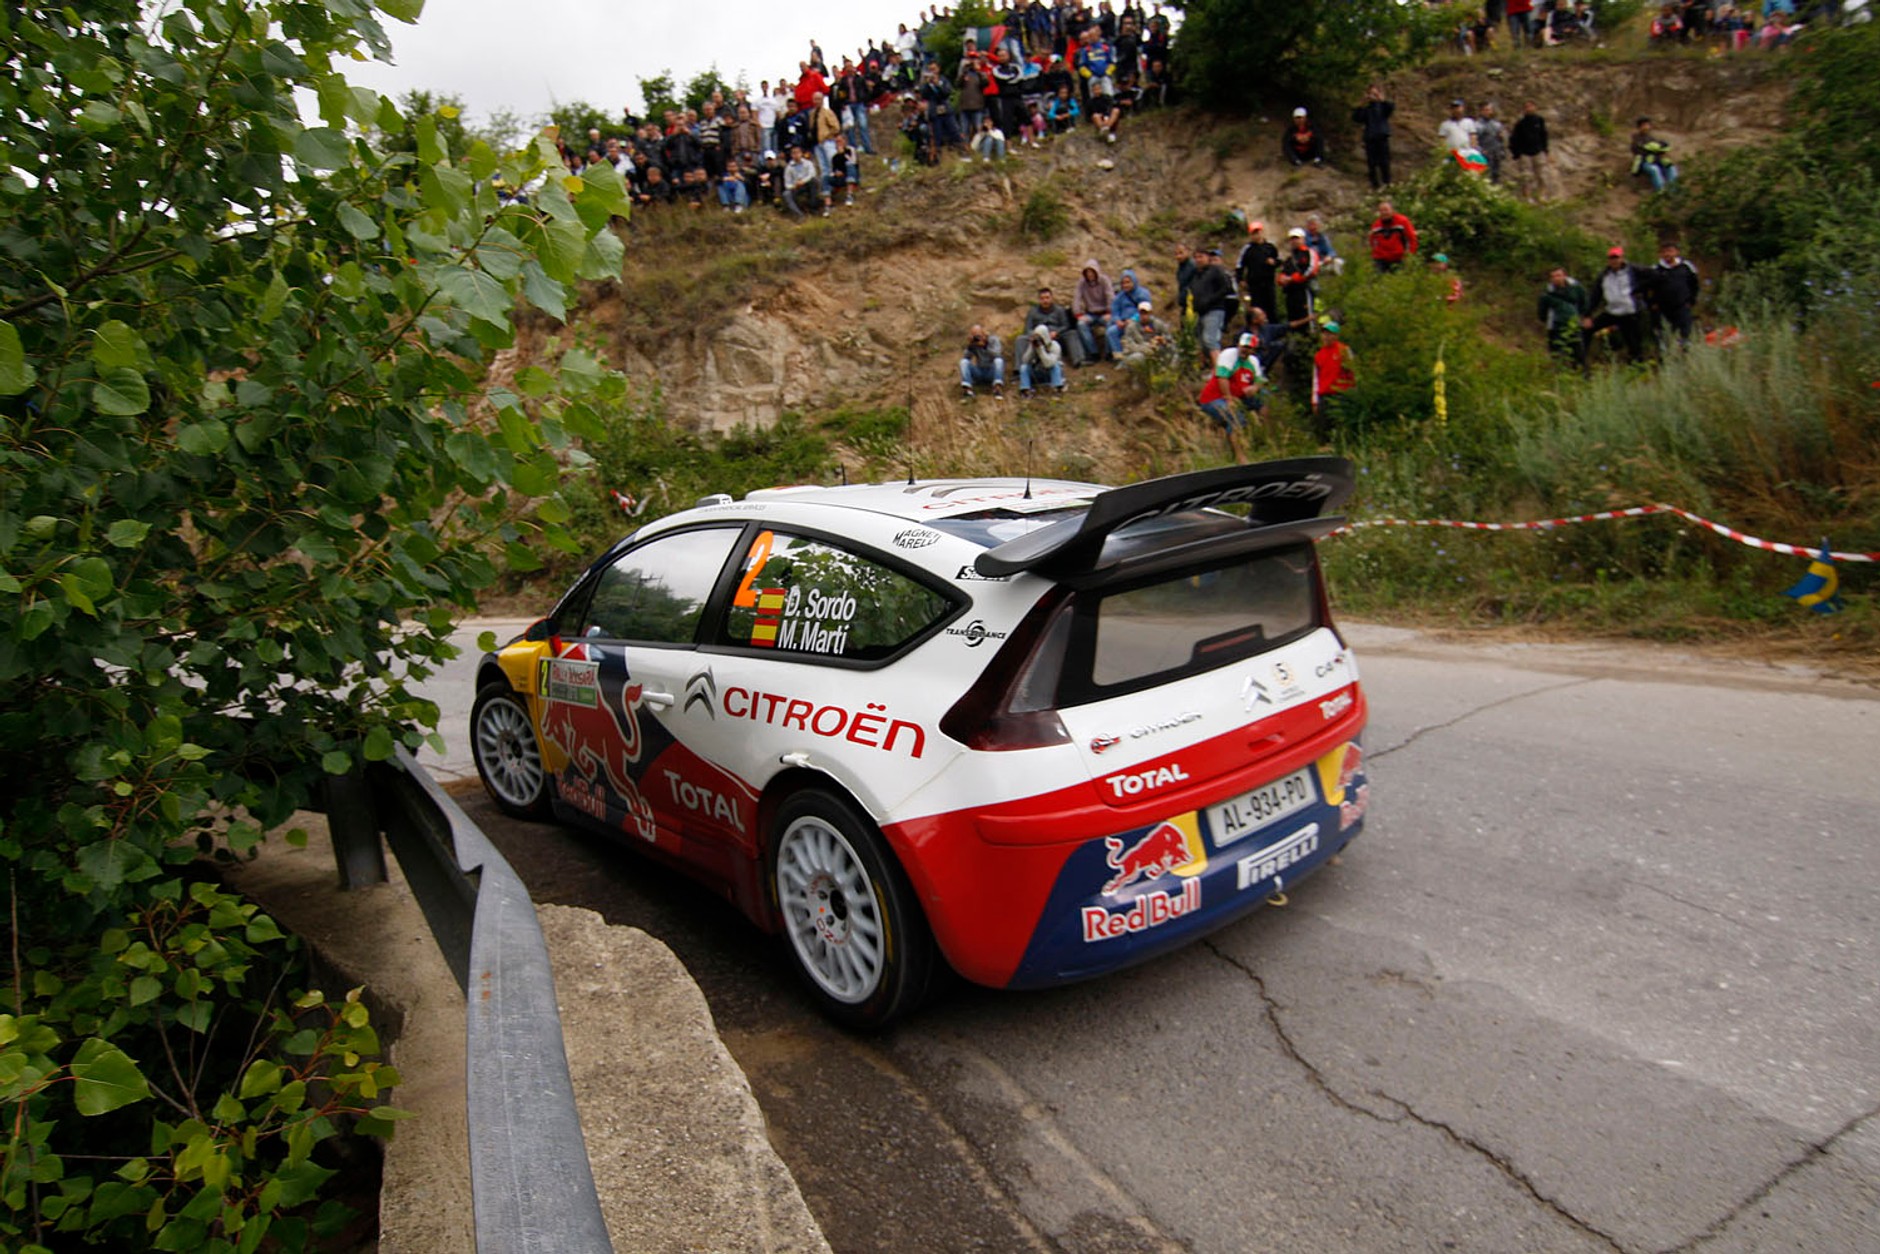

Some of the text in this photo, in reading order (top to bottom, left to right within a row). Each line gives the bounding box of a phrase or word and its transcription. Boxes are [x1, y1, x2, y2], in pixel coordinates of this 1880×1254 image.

[733, 530, 774, 607] 2
[784, 585, 857, 621] D. Sordo
[778, 620, 798, 649] M.
[541, 660, 549, 698] 2
[663, 769, 746, 834] TOTAL
[1105, 763, 1190, 798] TOTAL
[1237, 822, 1319, 890] PIRELLI
[1081, 876, 1201, 943] Red Bull
